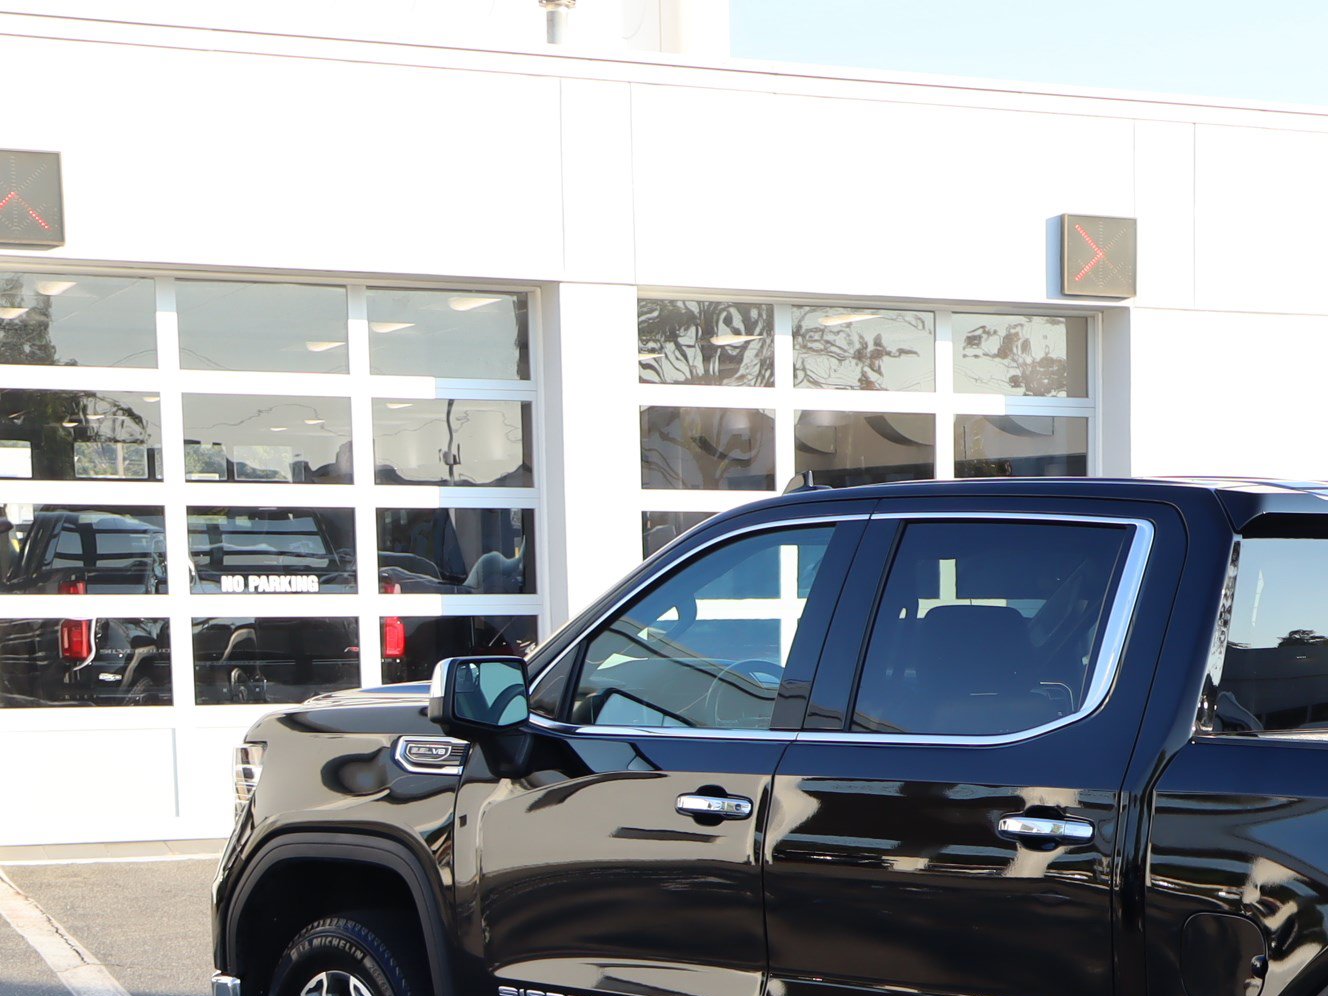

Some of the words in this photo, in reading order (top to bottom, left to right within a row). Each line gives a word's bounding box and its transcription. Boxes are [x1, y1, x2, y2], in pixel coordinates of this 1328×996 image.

[221, 575, 245, 593] NO
[248, 575, 319, 593] PARKING
[312, 936, 364, 961] MICHELIN
